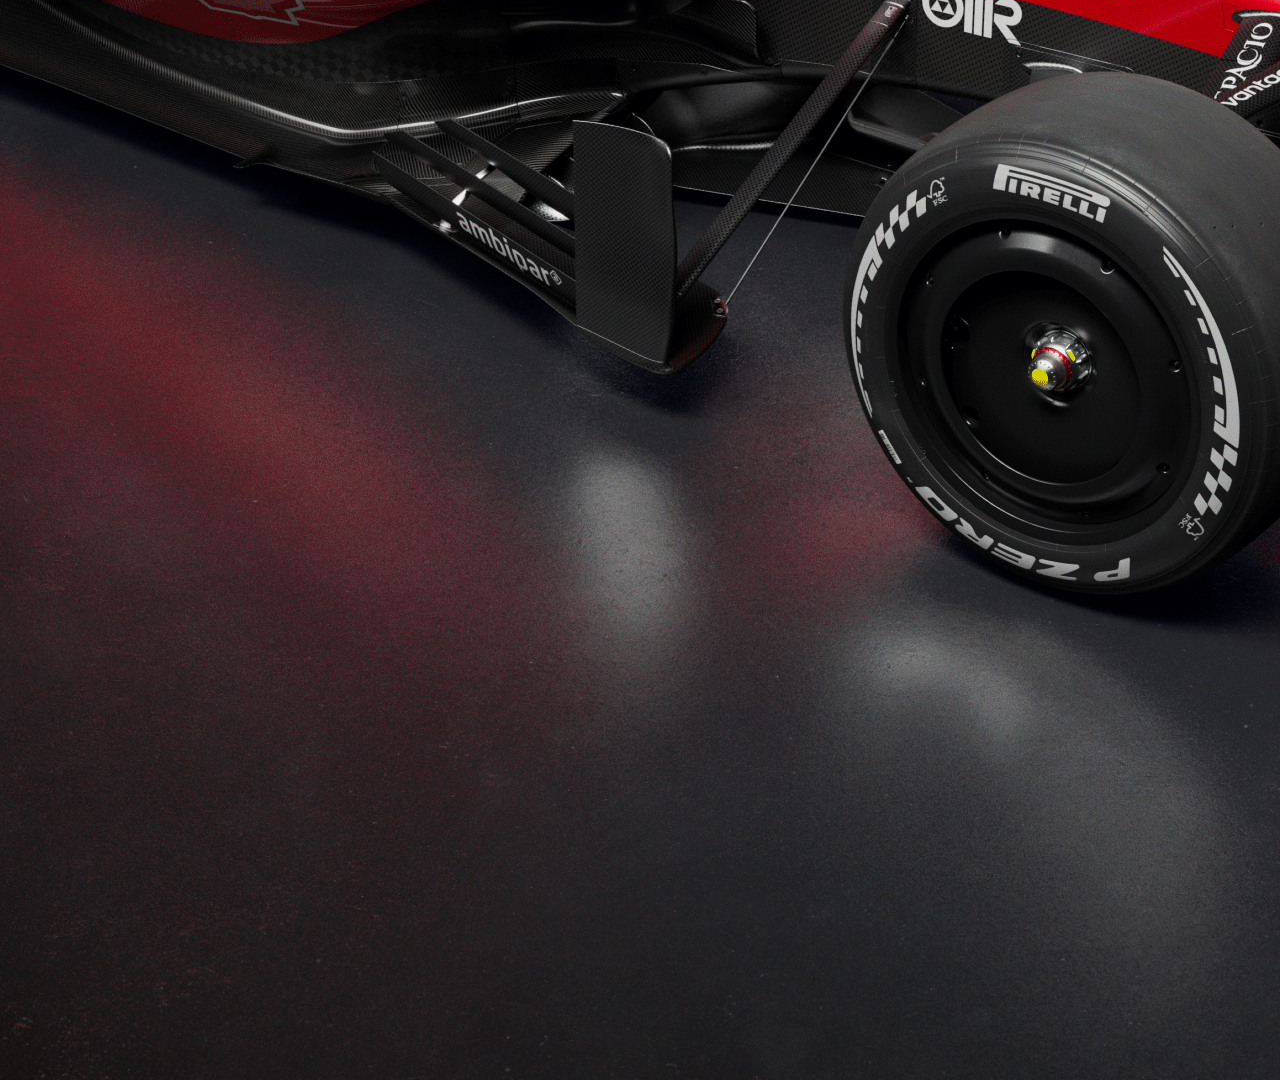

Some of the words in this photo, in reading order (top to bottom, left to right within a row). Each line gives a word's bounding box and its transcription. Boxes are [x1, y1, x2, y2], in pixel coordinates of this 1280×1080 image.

[1213, 22, 1274, 100] PACIO
[992, 163, 1111, 223] PIRELLI
[914, 485, 1081, 581] ZERO
[1093, 557, 1131, 582] P
